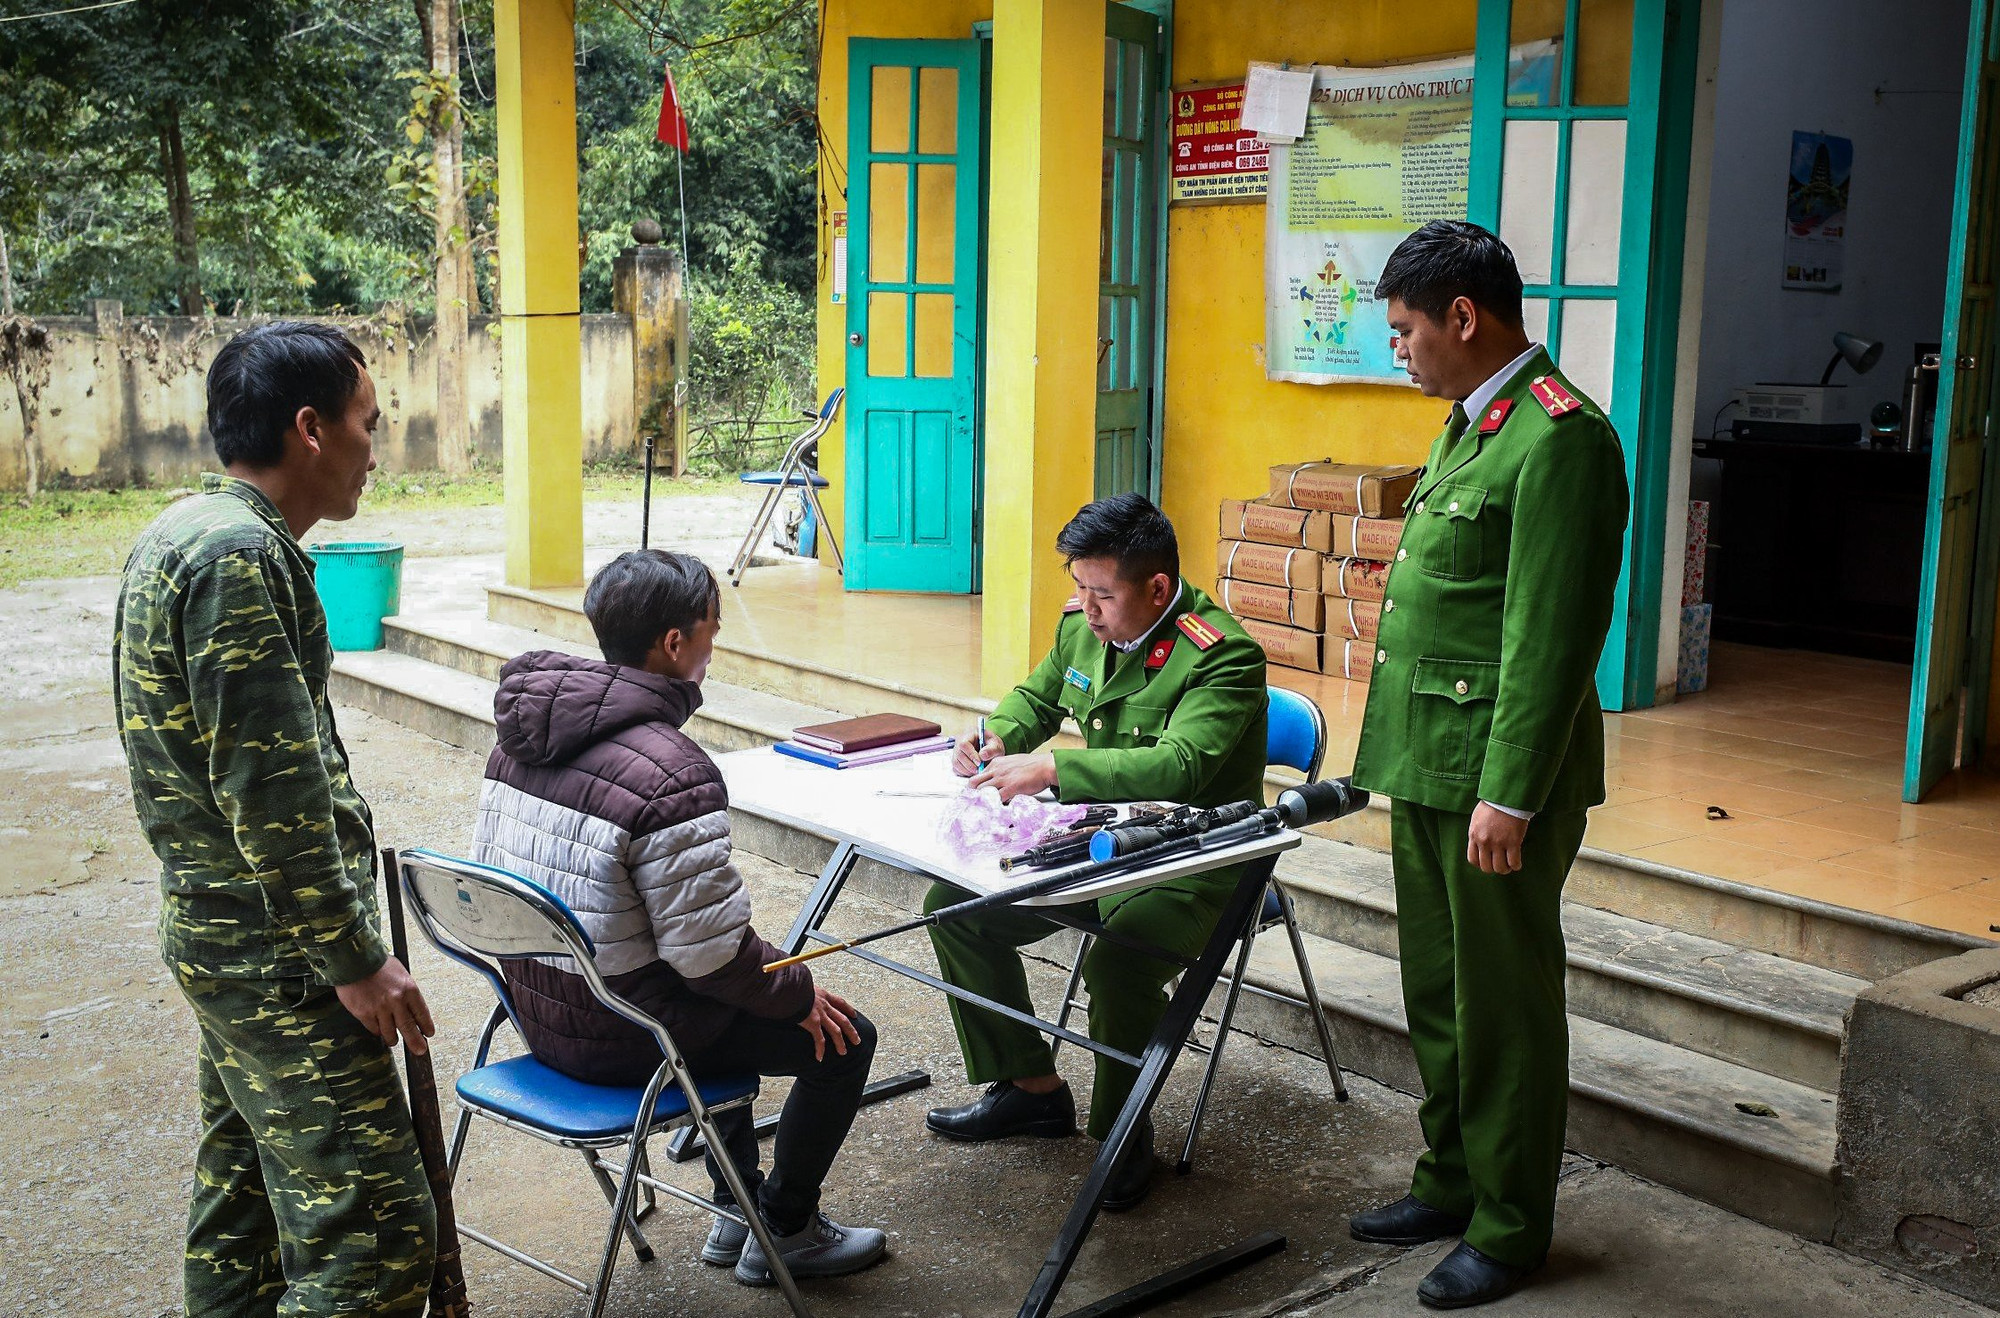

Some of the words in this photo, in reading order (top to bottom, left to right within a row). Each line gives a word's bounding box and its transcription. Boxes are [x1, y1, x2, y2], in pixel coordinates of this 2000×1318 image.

[1225, 90, 1238, 99] CÔNG
[1333, 88, 1364, 106] DỊCH
[1367, 87, 1386, 104] VỤ
[1388, 81, 1425, 100] CÔNG
[1428, 77, 1462, 97] TRỰC
[1203, 103, 1217, 113] CÔNG
[1217, 103, 1225, 111] AN
[1176, 121, 1194, 137] ĐƯỜNG
[1194, 119, 1204, 136] DÂY
[1205, 118, 1220, 134] NÓNG
[1220, 114, 1230, 133] CỦA
[1203, 145, 1211, 154] BỘ
[1211, 143, 1225, 152] CÔNG
[1240, 140, 1251, 151] 069
[1176, 162, 1189, 172] CÔNG
[1189, 163, 1197, 171] AN
[1197, 160, 1208, 170] TỈNH
[1209, 160, 1221, 171] ĐIỆN
[1239, 157, 1250, 168] 069
[1178, 177, 1186, 187] TIẾP
[1187, 178, 1198, 188] NHẬN
[1206, 175, 1218, 185] PHẢN
[1218, 175, 1228, 184] ÁNH
[1234, 174, 1244, 185] HIỆN
[1245, 174, 1260, 185] TƯỢNG
[1182, 189, 1193, 197] THAM
[1194, 187, 1208, 197] NHŨNG
[1209, 185, 1217, 195] CỦA
[1218, 186, 1226, 195] CÁN
[1296, 487, 1316, 499] CHINA
[1317, 489, 1323, 500] IN
[1325, 490, 1344, 502] MADE
[1246, 517, 1263, 529] MADE
[1263, 519, 1271, 530] IN
[1271, 521, 1290, 533] CHINA
[1361, 532, 1380, 544] MADE
[1380, 534, 1387, 546] IN
[1241, 557, 1258, 569] MADE
[1258, 560, 1265, 571] IN
[1265, 561, 1284, 573] CHINA
[1241, 595, 1258, 607] MADE
[1258, 598, 1265, 609] IN
[1265, 599, 1284, 611] CHINA
[1267, 639, 1286, 652] CHINA
